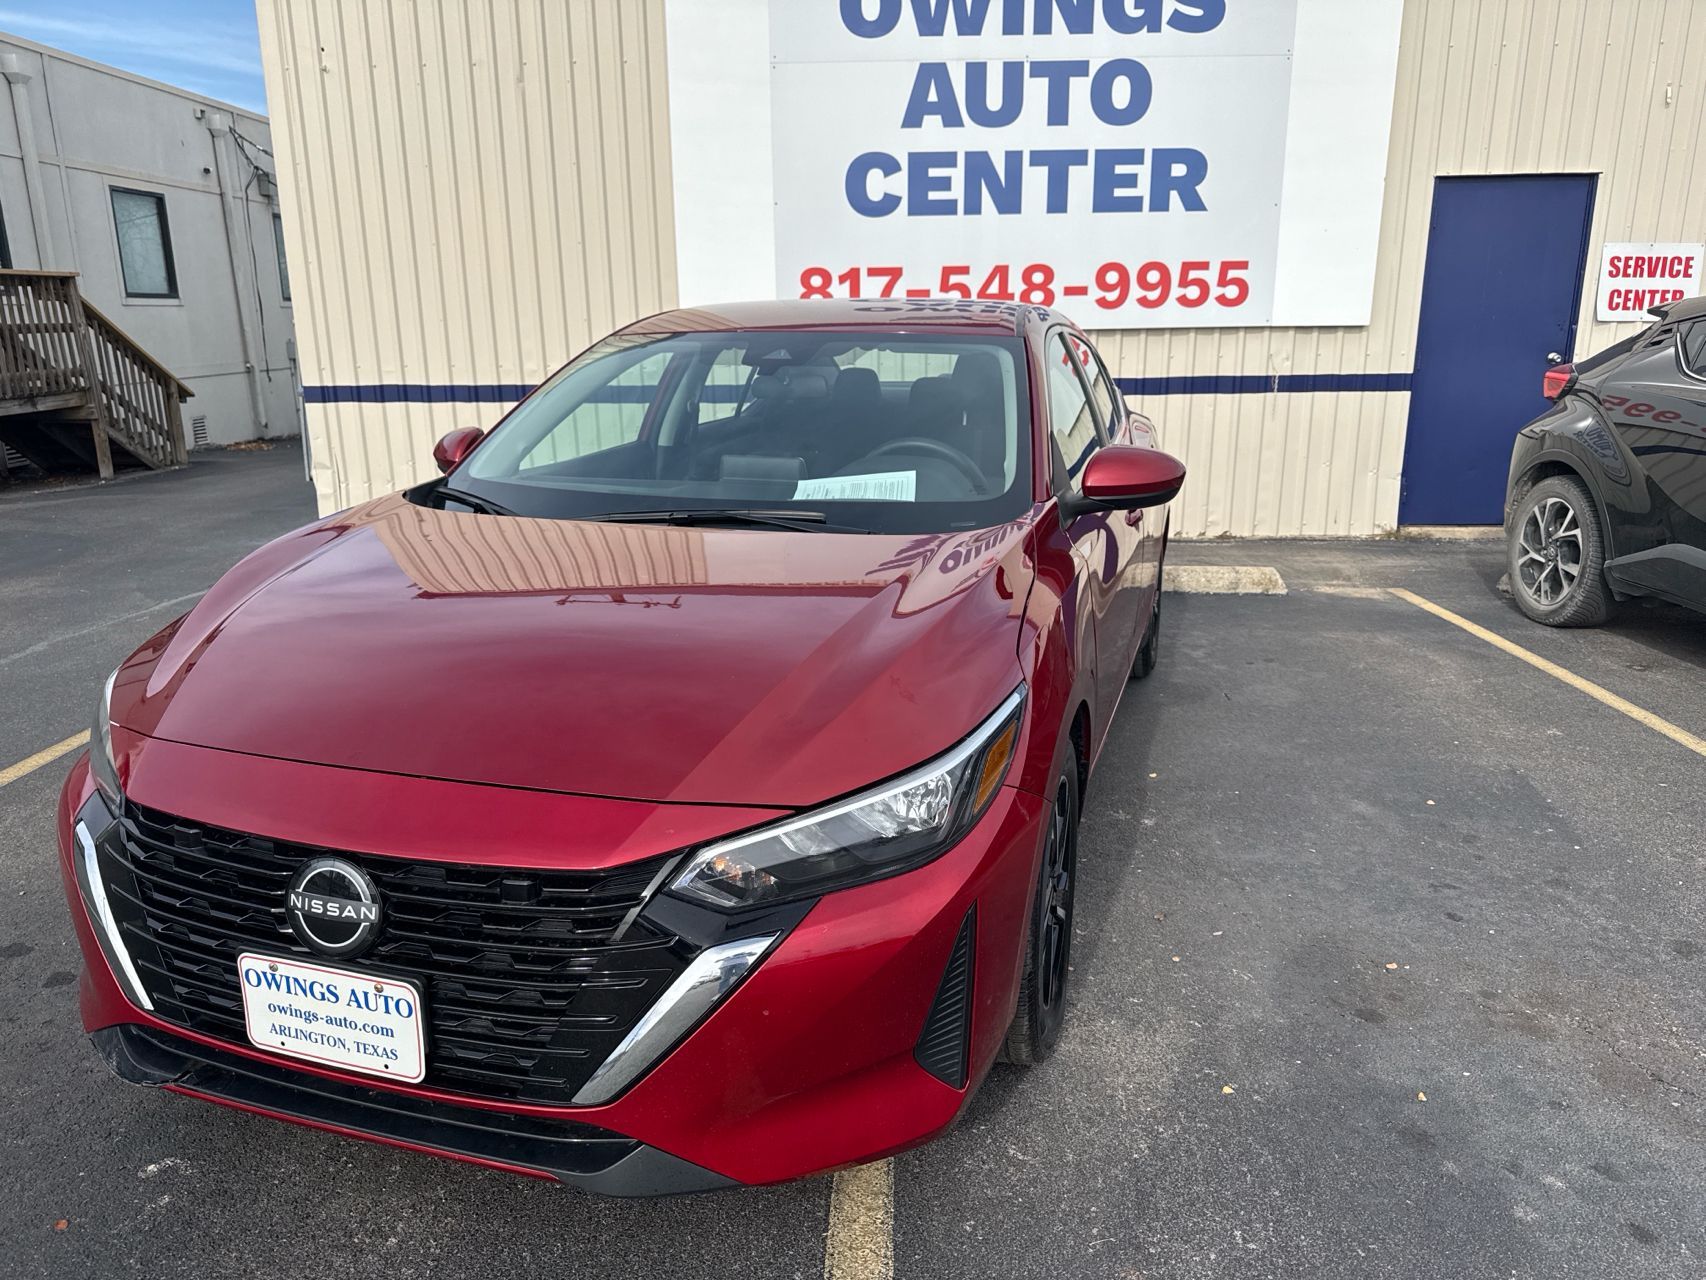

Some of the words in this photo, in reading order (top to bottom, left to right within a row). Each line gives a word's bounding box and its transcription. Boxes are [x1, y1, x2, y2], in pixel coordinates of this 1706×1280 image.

[902, 58, 1153, 129] AUTO
[845, 147, 1209, 218] CENTER
[799, 260, 1250, 310] 817-548-9955
[1608, 255, 1694, 279] SERVICE
[1607, 288, 1685, 311] CENTER
[290, 893, 376, 920] NISSAN
[244, 968, 340, 1004] OWINGS
[346, 988, 414, 1019] AUTO
[268, 1002, 395, 1038] owings-auto.com
[269, 1022, 351, 1053] ARLINGTON,
[353, 1041, 399, 1061] TEXAS
